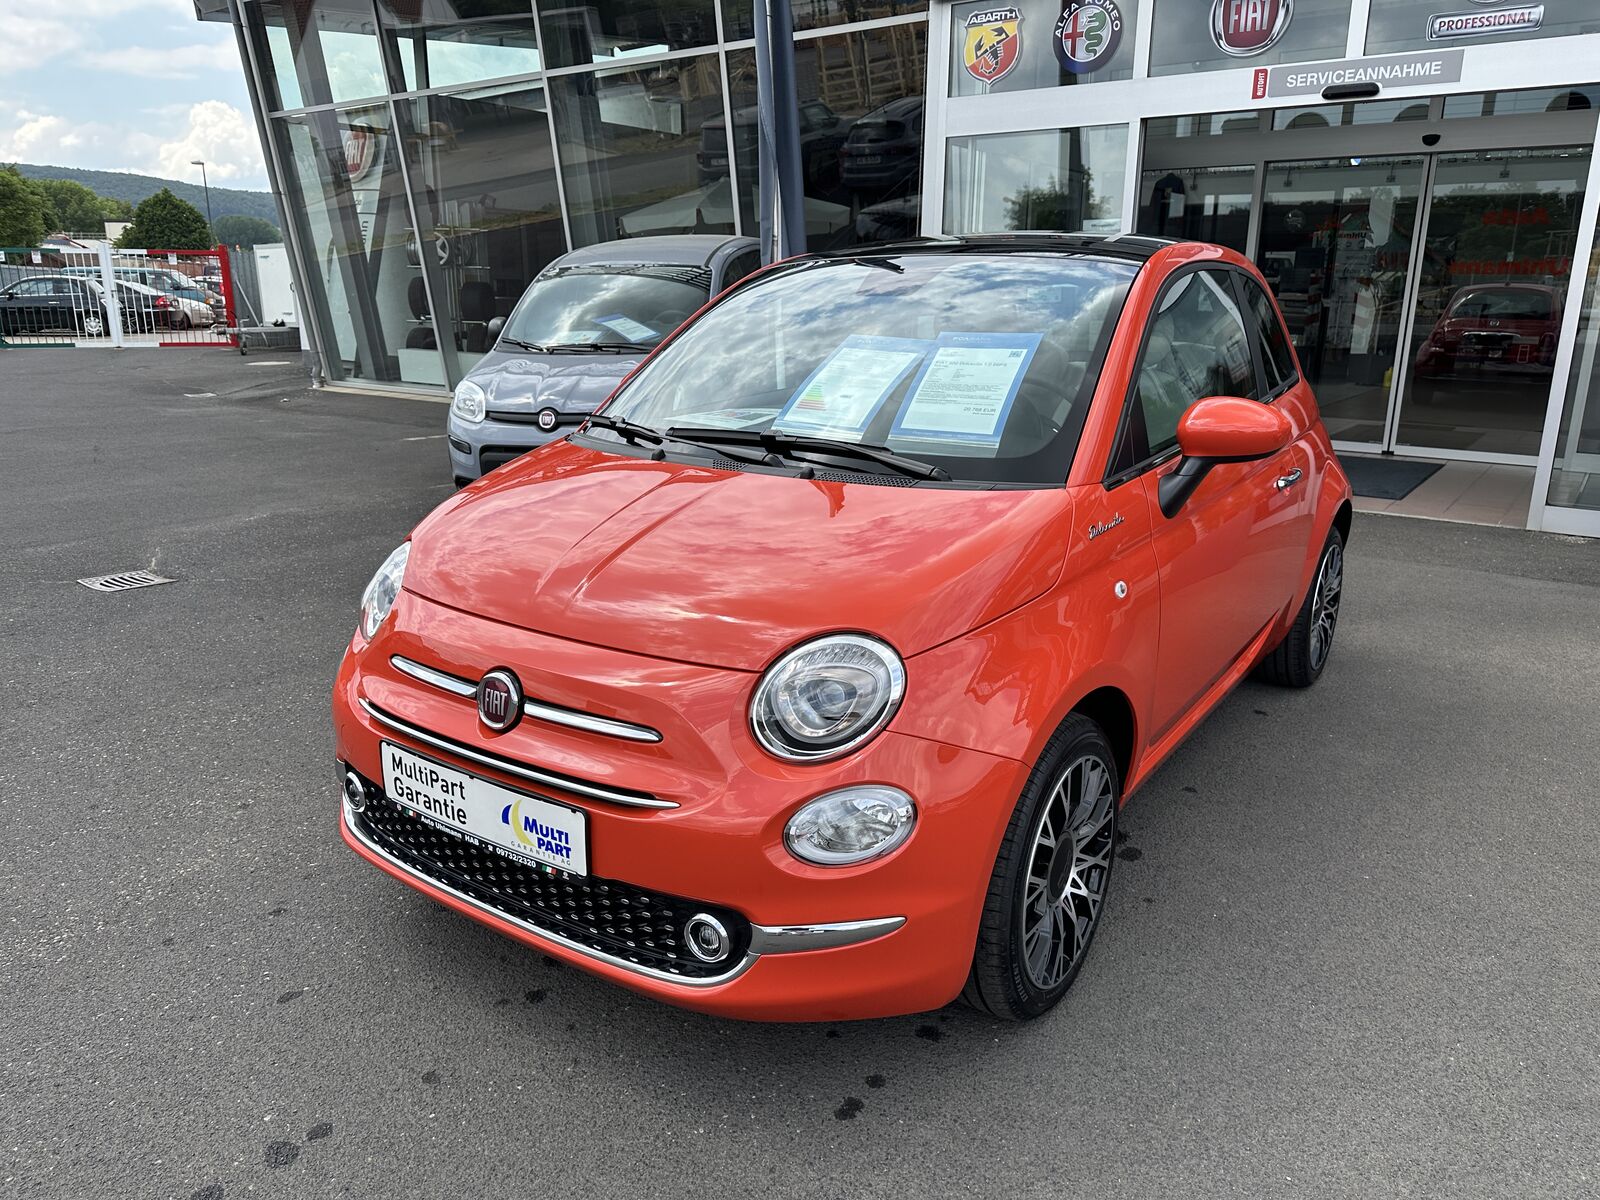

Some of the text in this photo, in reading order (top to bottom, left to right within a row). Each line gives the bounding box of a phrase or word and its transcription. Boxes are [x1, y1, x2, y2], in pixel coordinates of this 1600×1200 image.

[969, 11, 1016, 25] ABARTH
[1055, 3, 1079, 38] ALFA
[1228, 0, 1271, 34] FIAT
[1437, 11, 1534, 32] PROFESSIONAL
[1286, 61, 1443, 88] SERVICEANNAHME
[484, 688, 508, 716] FIAT
[391, 752, 466, 801] MultiPart
[394, 776, 467, 825] Garantie
[420, 815, 537, 868] Auto Uhlmann HAB 09732/2320
[510, 840, 571, 866] GARANTIE AG
[537, 837, 572, 859] PART
